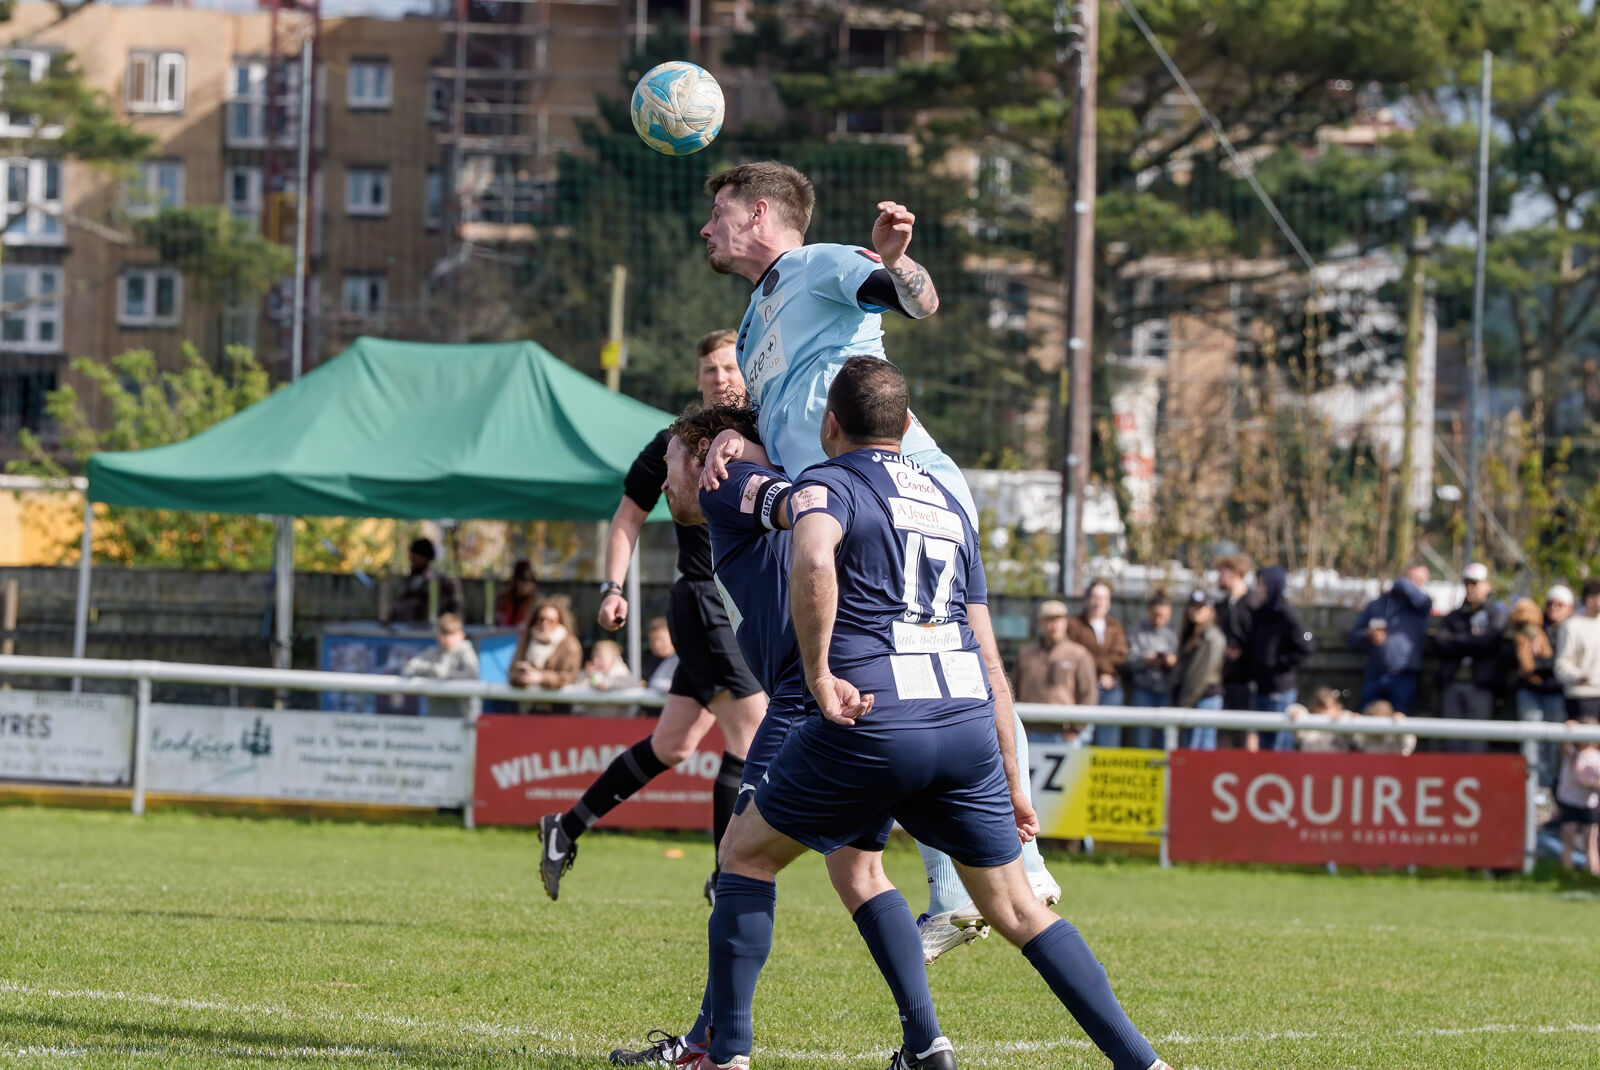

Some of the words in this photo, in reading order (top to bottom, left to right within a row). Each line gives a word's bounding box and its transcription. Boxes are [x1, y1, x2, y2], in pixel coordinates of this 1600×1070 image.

[762, 485, 781, 517] CAPTAIN
[896, 503, 906, 516] A
[908, 505, 940, 524] Jewell
[902, 531, 960, 625] 17
[490, 744, 628, 790] WILLIAM
[1091, 773, 1158, 788] VEHICLE
[1210, 772, 1482, 829] SQUIRES
[1087, 803, 1156, 826] SIGNS
[1351, 829, 1480, 846] RESTAURANT
